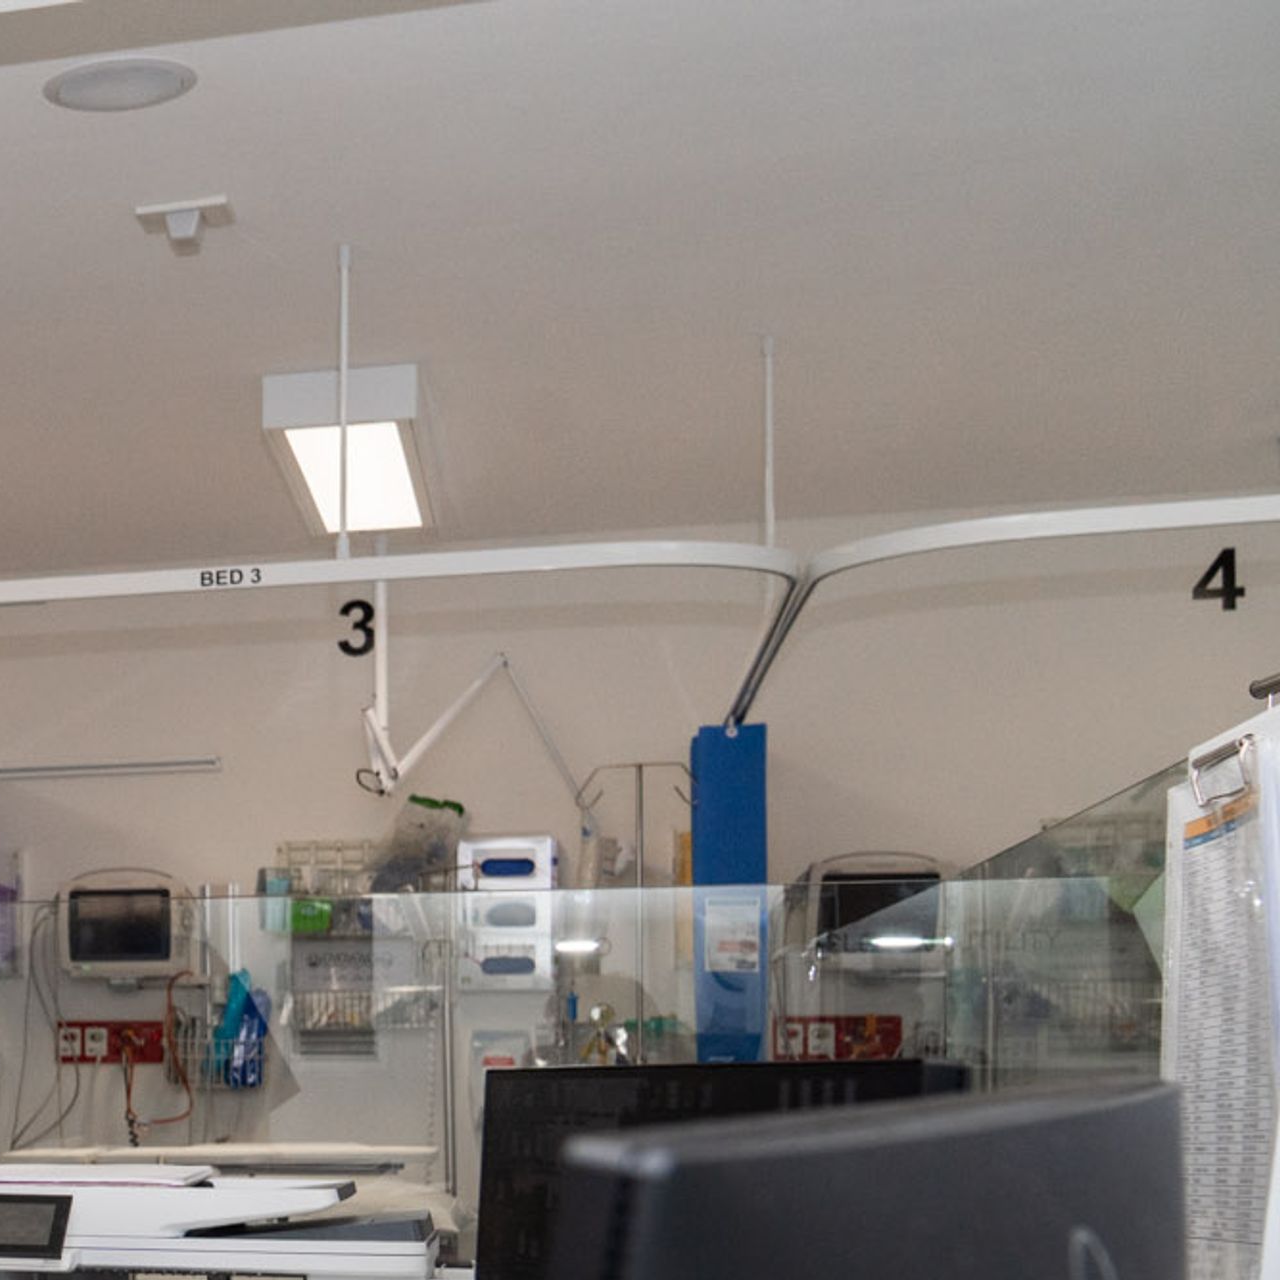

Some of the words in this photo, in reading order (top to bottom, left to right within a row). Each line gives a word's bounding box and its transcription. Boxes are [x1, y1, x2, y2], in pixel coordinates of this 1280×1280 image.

[200, 569, 244, 587] BED
[250, 567, 262, 584] 3
[1192, 547, 1246, 612] 4
[337, 599, 375, 657] 3
